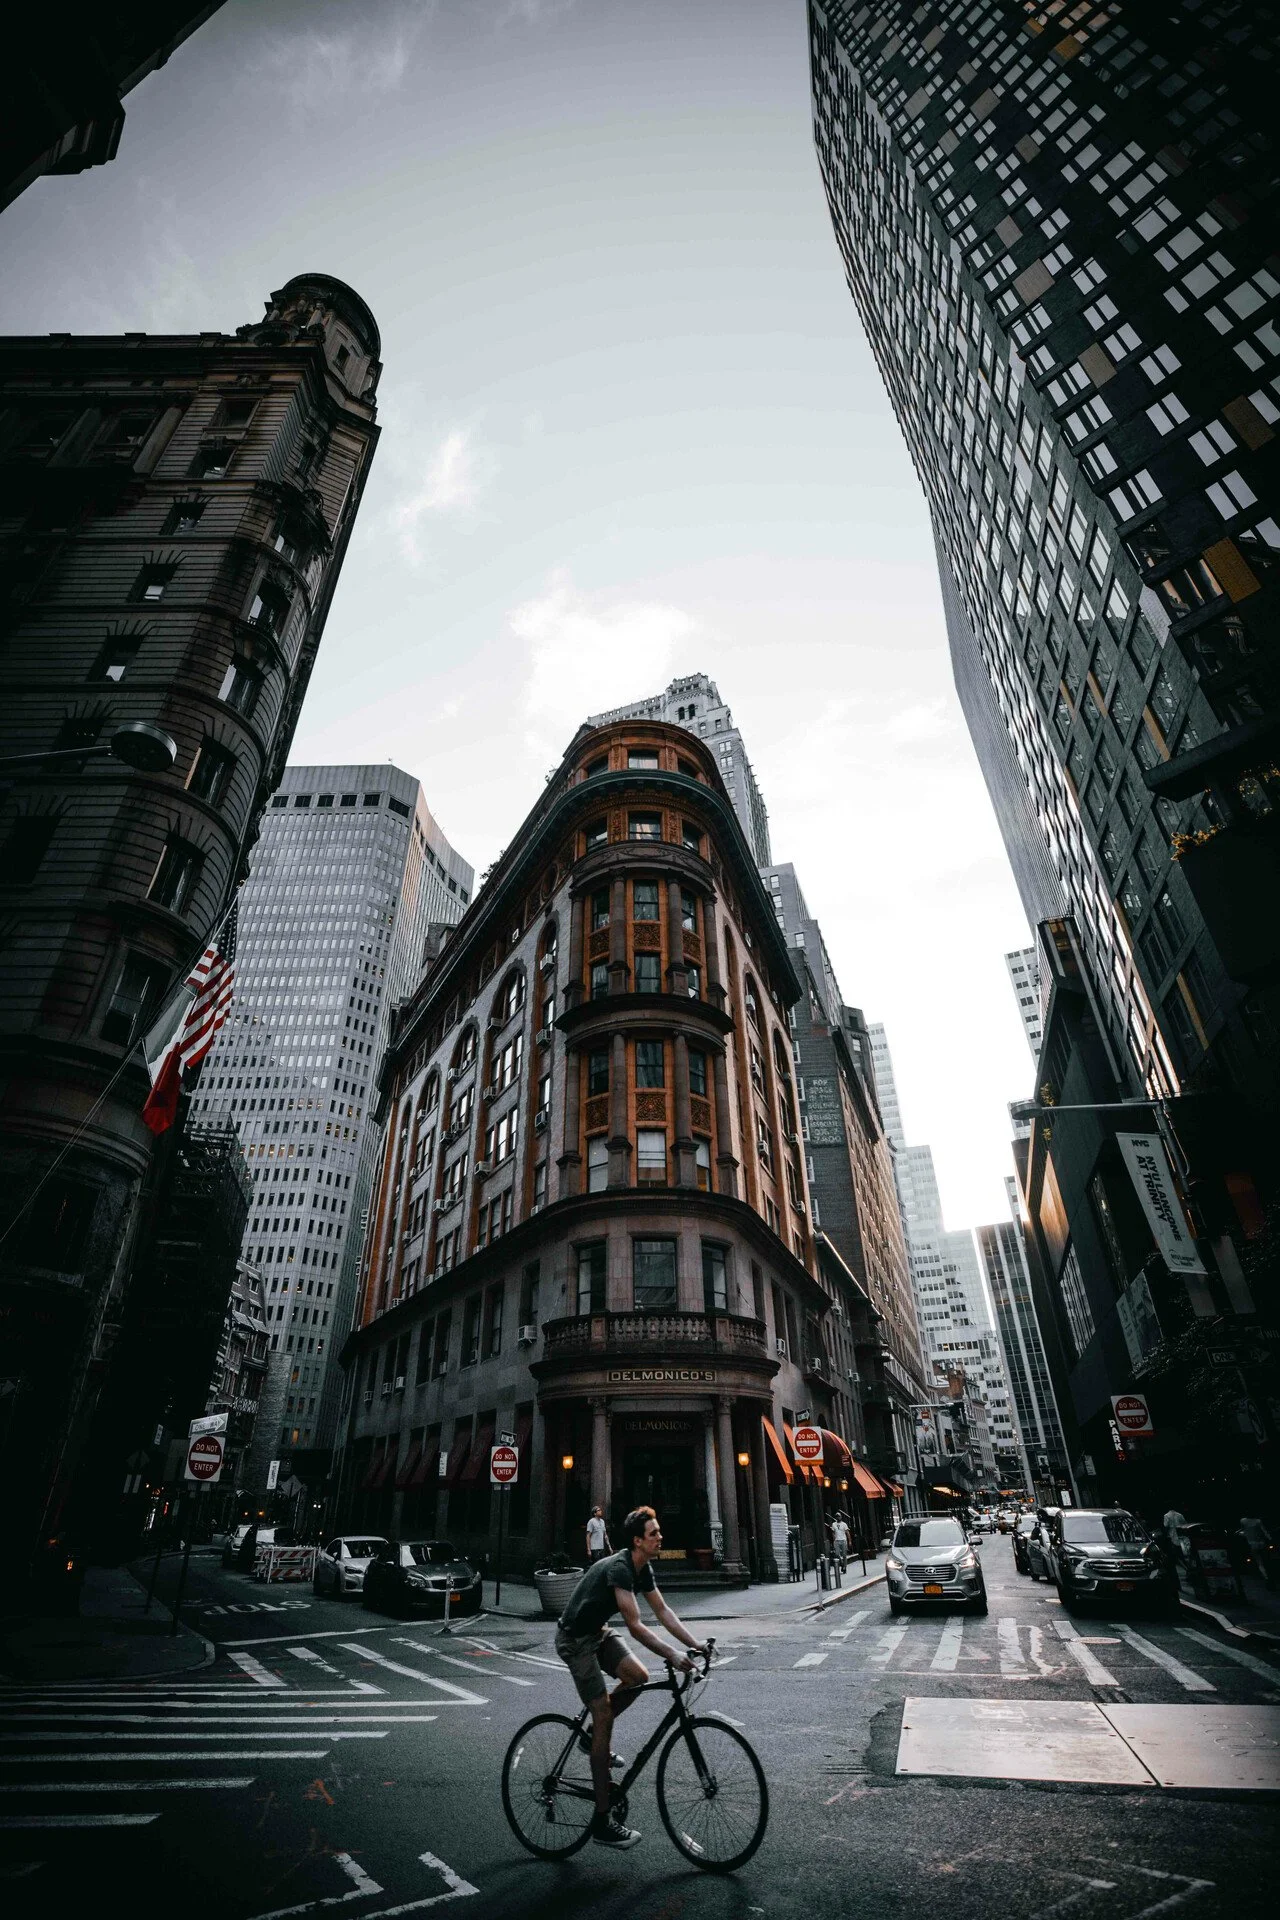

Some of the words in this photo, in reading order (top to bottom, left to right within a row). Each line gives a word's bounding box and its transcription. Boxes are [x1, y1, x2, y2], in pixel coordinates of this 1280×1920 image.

[1136, 1154, 1149, 1171] AT
[1143, 1172, 1168, 1222] TRINITY
[1145, 1154, 1161, 1181] NYU
[1154, 1181, 1183, 1242] LANGONE
[1214, 1351, 1234, 1362] ONE
[610, 1370, 714, 1381] DELMONICO'S
[1129, 1401, 1141, 1409] NOT
[1122, 1416, 1145, 1425] ENTER
[1108, 1419, 1123, 1451] PARK
[195, 1443, 205, 1451] DO
[206, 1444, 219, 1453] NOT
[193, 1462, 214, 1472] ENTER
[496, 1468, 513, 1476] ENTER
[203, 1600, 313, 1615] STOP
